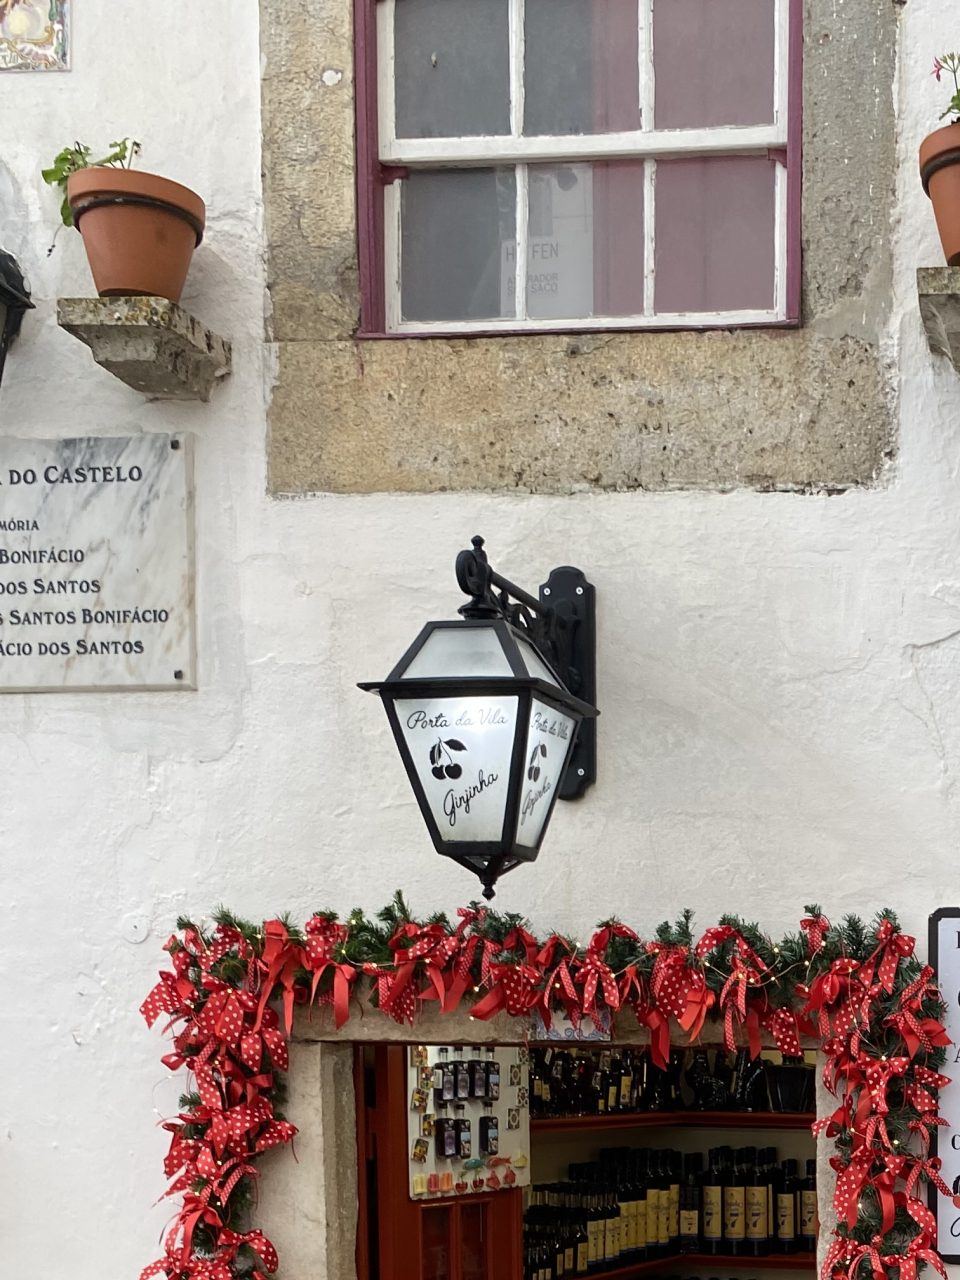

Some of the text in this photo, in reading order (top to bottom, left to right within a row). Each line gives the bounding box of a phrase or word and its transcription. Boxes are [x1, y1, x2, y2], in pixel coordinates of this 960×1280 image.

[9, 465, 143, 485] DO CASTELO
[0, 546, 85, 564] BONIFÁCIO
[33, 578, 101, 594] SANTOS
[10, 608, 76, 625] SANTOS
[82, 606, 169, 624] BONIFÁCIO
[38, 642, 70, 655] DOS
[76, 639, 144, 655] SANTOS
[406, 709, 508, 729] Porta da Vila
[443, 769, 498, 826] Ginjinha
